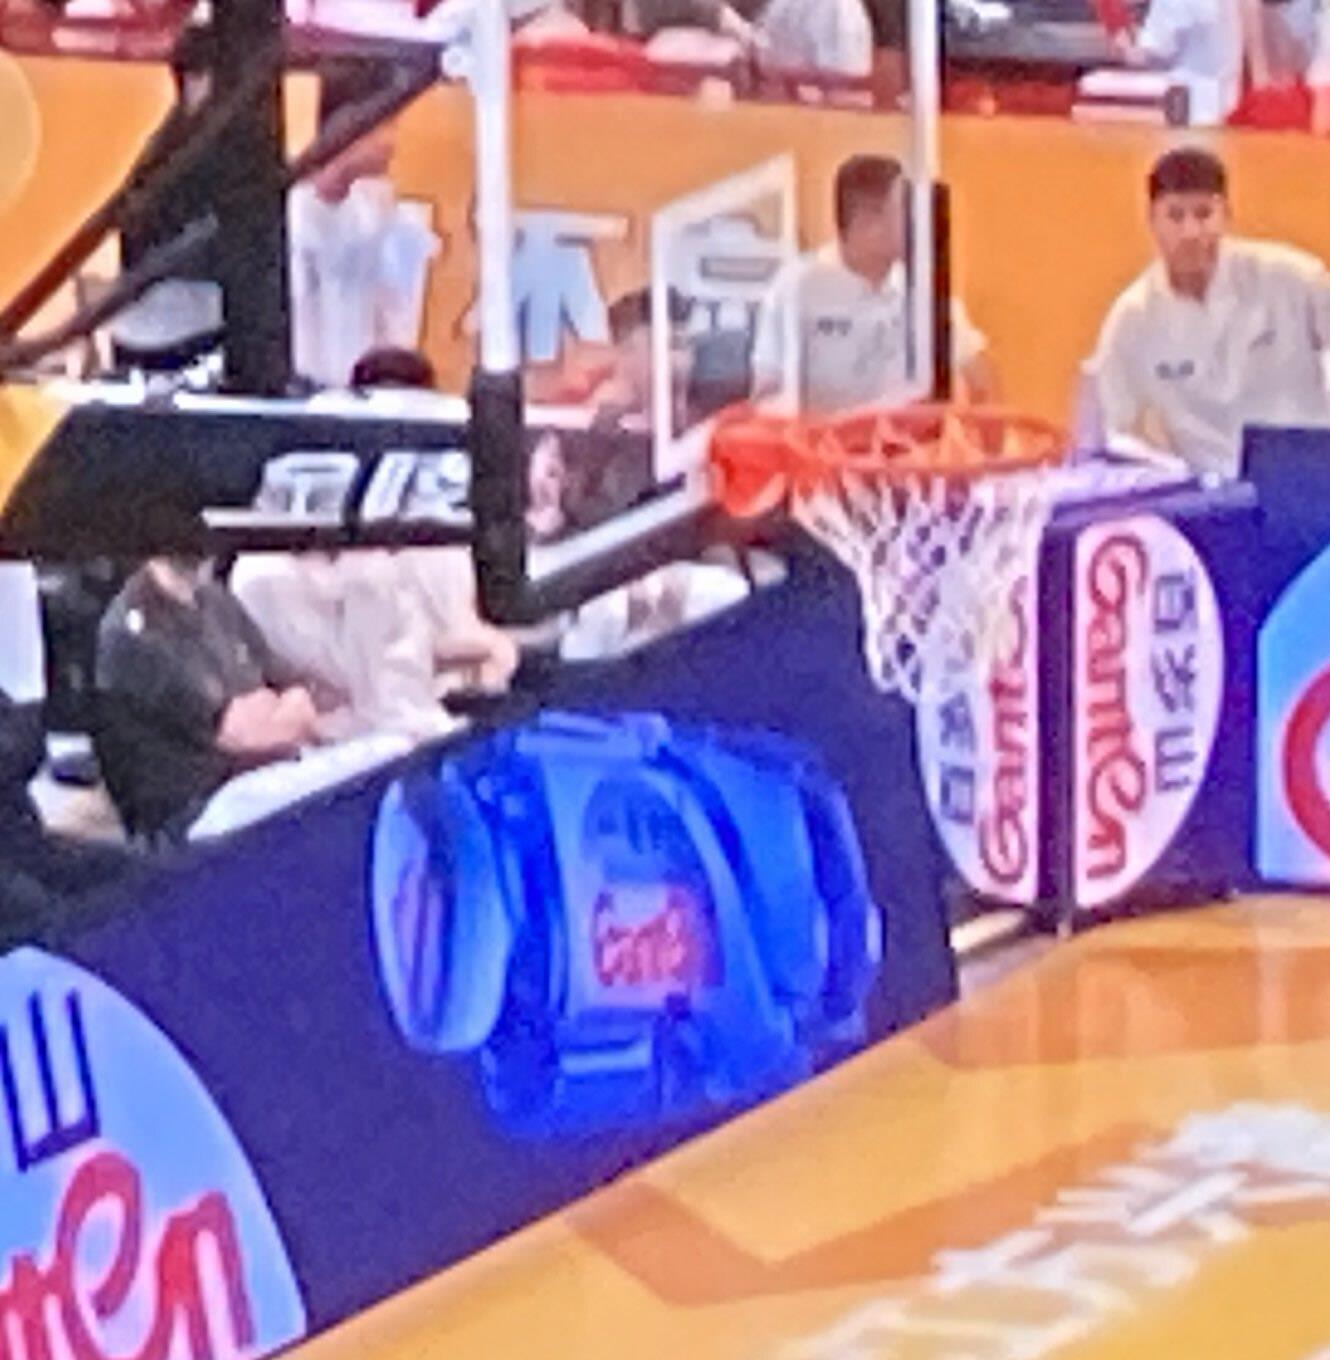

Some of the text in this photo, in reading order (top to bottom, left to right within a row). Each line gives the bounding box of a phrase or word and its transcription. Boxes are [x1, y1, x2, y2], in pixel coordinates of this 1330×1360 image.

[980, 572, 1029, 885] Gant
[1153, 567, 1199, 793] 百岁山
[0, 990, 99, 1172] 山
